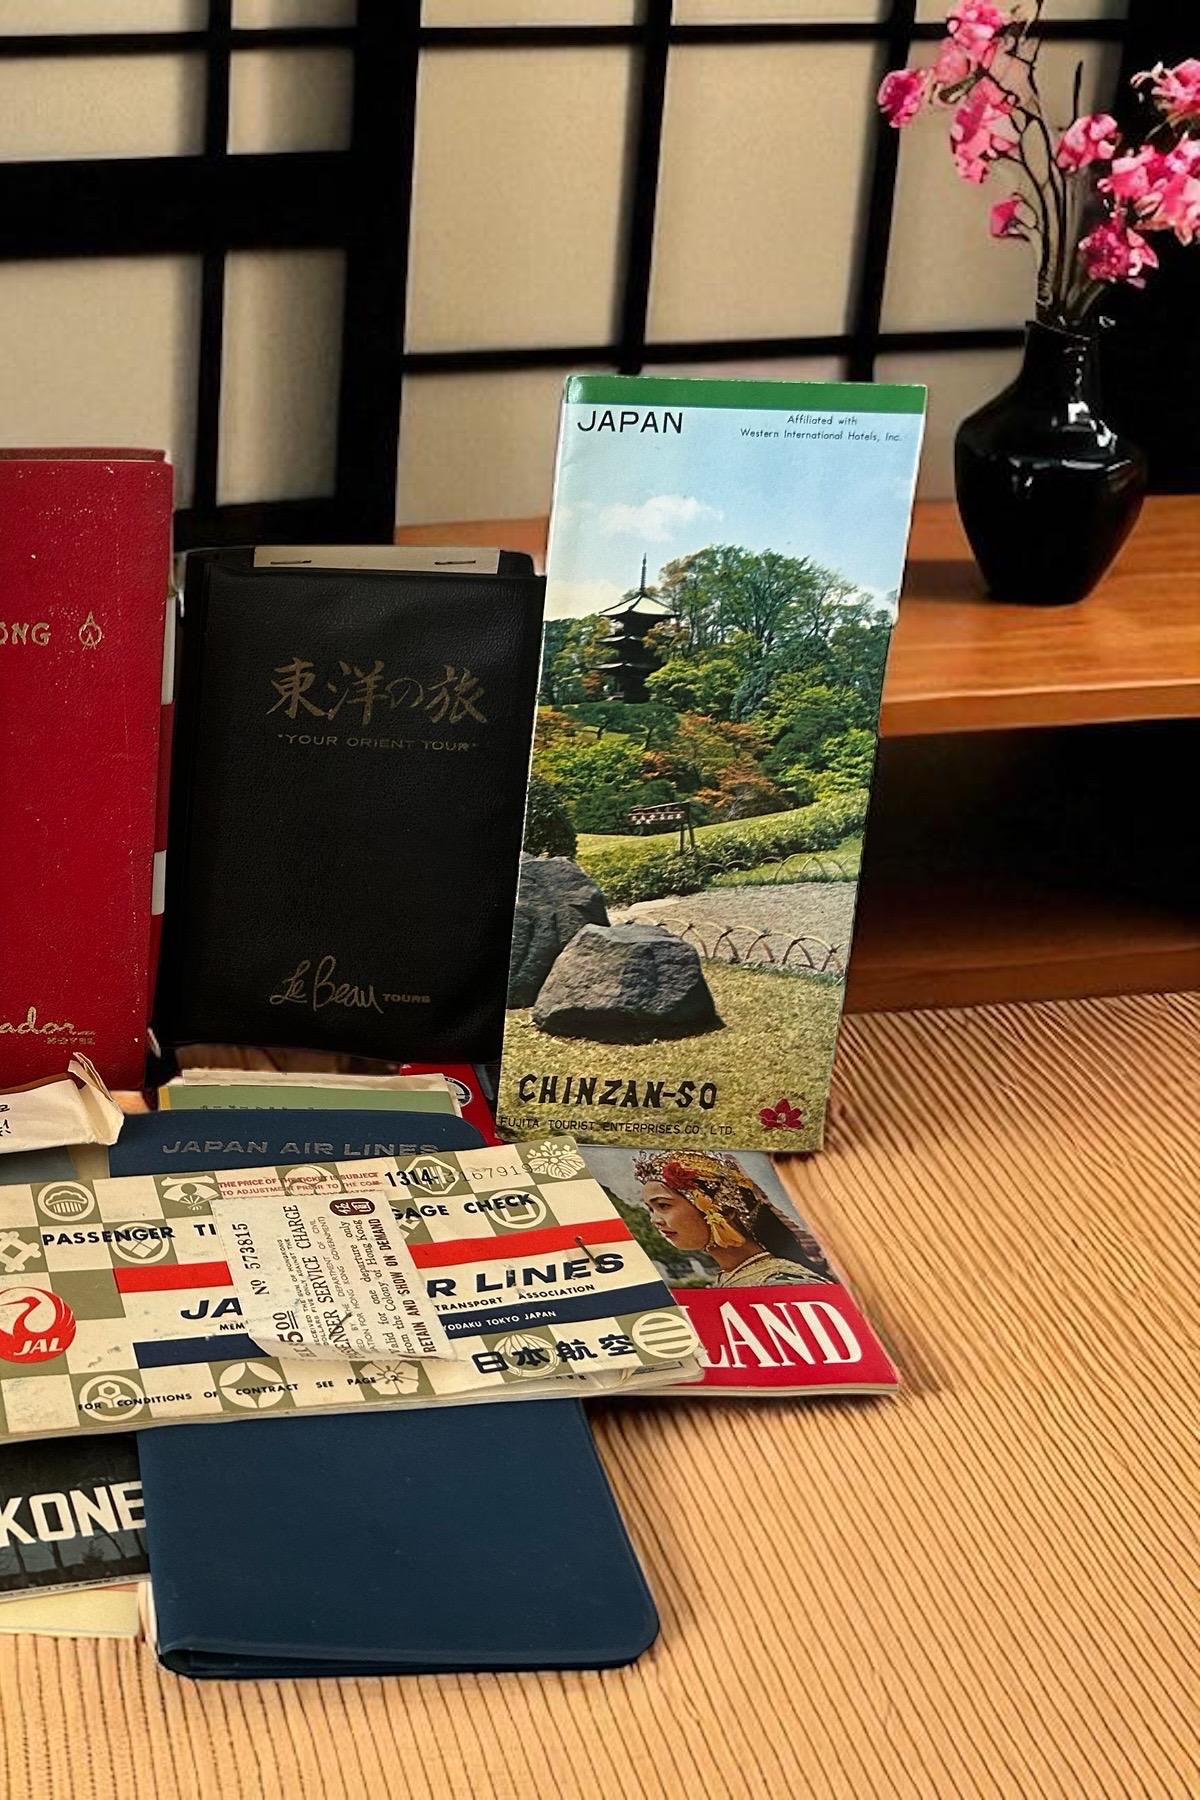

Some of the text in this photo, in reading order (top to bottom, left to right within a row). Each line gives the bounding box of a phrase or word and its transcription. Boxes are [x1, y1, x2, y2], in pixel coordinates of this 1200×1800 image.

[577, 410, 683, 434] JAPAN
[787, 415, 858, 426] Affiliated with
[740, 427, 779, 439] Western
[784, 429, 844, 441] International
[848, 431, 880, 443] Hotels,
[266, 656, 488, 726] 東洋の旅
[346, 737, 416, 749] ORIENT
[269, 954, 432, 1014] Le Beau TOURS
[518, 1073, 718, 1110] CHINZAN-SO
[499, 1116, 540, 1129] FUJITA
[548, 1119, 595, 1131] TOURIST
[602, 1121, 680, 1135] ENTERPRISES
[709, 1125, 737, 1136] LTD.
[162, 1140, 440, 1157] JAPAN AIR LINES
[218, 1181, 238, 1189] THE
[238, 1179, 264, 1188] PRICE
[341, 1171, 379, 1181] SUBJECT
[463, 1193, 536, 1214] CHECK
[42, 1226, 175, 1246] PASSENGER
[282, 1204, 311, 1248] CHARGE
[338, 1220, 353, 1237] only
[352, 1219, 367, 1241] Kong
[231, 1223, 260, 1269] 573815
[316, 1241, 325, 1249] OF
[362, 1242, 377, 1265] Hong
[350, 1244, 371, 1282] departure
[372, 1269, 382, 1277] of
[476, 1253, 625, 1293] LINES
[301, 1255, 333, 1302] SERVICE
[322, 1256, 345, 1296] DEPARTMENT
[336, 1265, 349, 1284] KONG
[368, 1218, 436, 1352] RETAIN AND SHOW ON DEMAND
[346, 1288, 360, 1308] HONG
[368, 1289, 380, 1304] one
[378, 1281, 396, 1311] Colony
[434, 1297, 503, 1312] TRANSPORT
[518, 1284, 596, 1300] ASSOCIATION
[356, 1312, 366, 1326] FOR
[377, 1312, 389, 1324] for
[392, 1315, 404, 1329] the
[486, 1315, 520, 1327] TOKYO
[524, 1310, 556, 1321] JAPAN
[678, 1300, 863, 1369] LAND
[13, 1337, 64, 1356] JAL
[472, 1333, 637, 1375] 日本航空
[78, 1402, 102, 1411] FOR
[116, 1393, 193, 1407] CONDITIONS
[203, 1390, 218, 1399] OF
[235, 1383, 299, 1396] CONTRACT
[315, 1380, 334, 1389] SEE
[347, 1376, 377, 1386] PAGE
